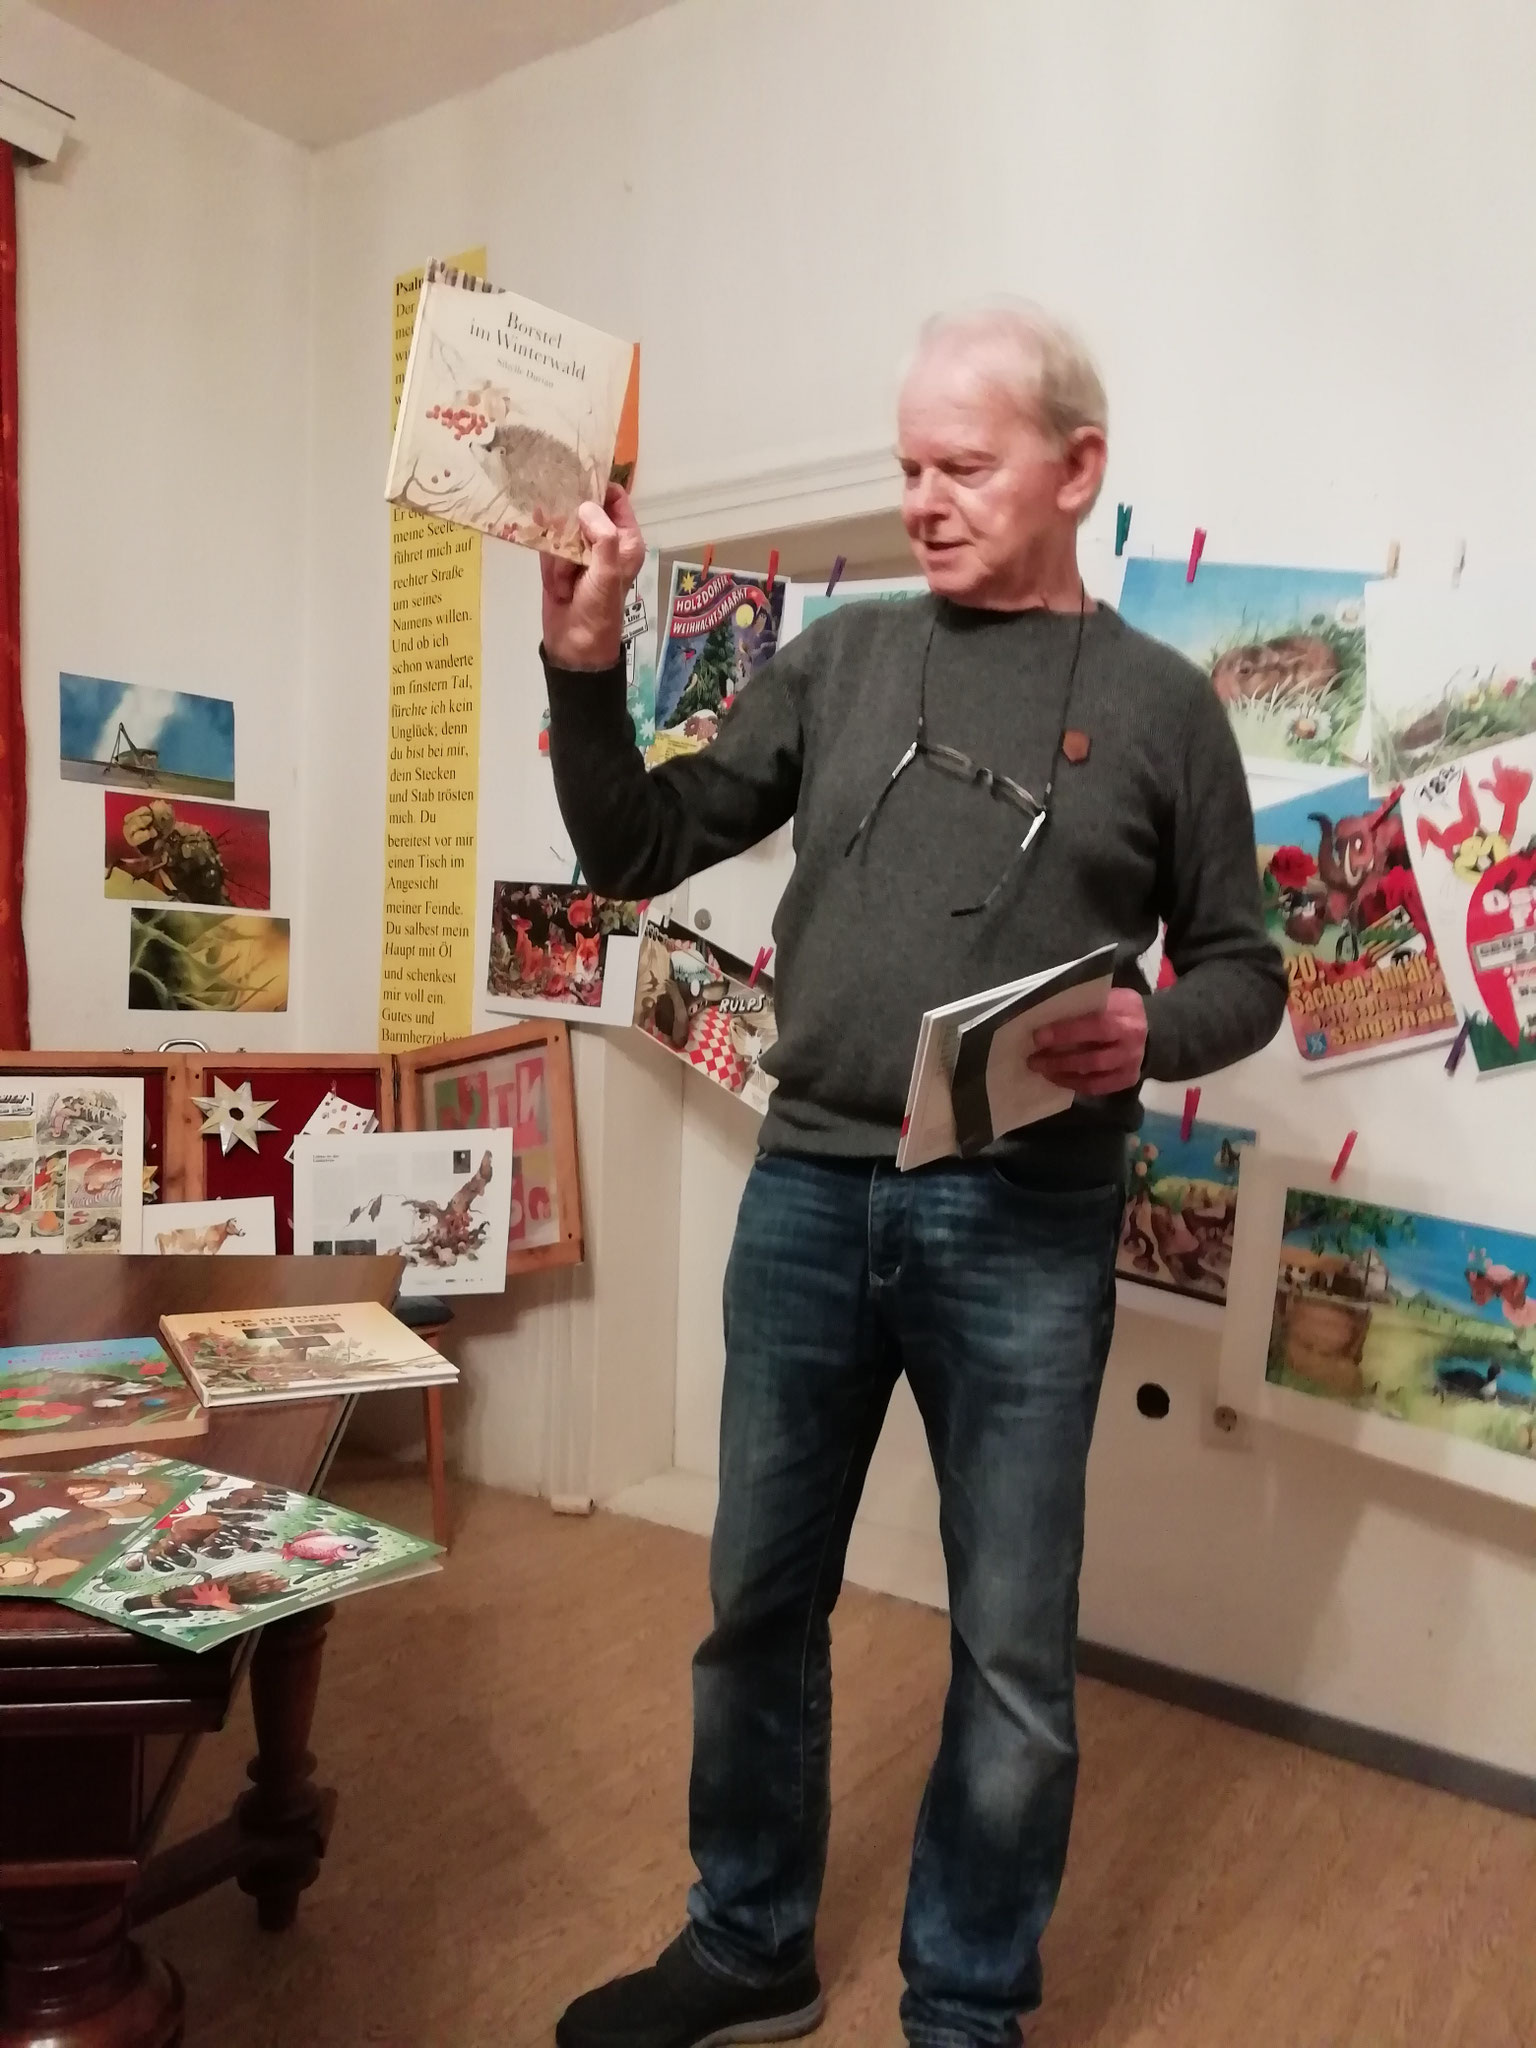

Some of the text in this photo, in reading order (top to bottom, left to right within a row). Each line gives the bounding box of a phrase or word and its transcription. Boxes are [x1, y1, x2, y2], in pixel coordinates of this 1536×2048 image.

[396, 303, 416, 318] Der
[395, 324, 414, 340] mei
[507, 311, 563, 349] Borstel
[469, 318, 586, 382] im Winterwald
[393, 508, 404, 522] Er
[393, 527, 424, 544] meine
[393, 536, 474, 565] führet mich auf
[393, 565, 464, 590] rechter Straße
[393, 593, 443, 611] um seines
[673, 587, 748, 635] WEIHNACHTSMARKT
[393, 610, 472, 632] Namens willen.
[392, 634, 449, 653] Und ob ich
[392, 654, 474, 674] schon wanderte
[392, 682, 406, 696] im
[409, 679, 448, 694] finstern
[391, 698, 473, 718] fürchte ich kein
[441, 721, 468, 736] denn
[390, 746, 403, 761] du
[406, 745, 425, 760] bist
[427, 743, 444, 757] bei
[390, 767, 456, 782] dein Stecken
[389, 788, 474, 803] und Stab trösten
[420, 809, 437, 823] Du
[388, 833, 474, 848] bereitest vor mir
[388, 854, 465, 869] einen Tisch im
[387, 876, 439, 893] Angesicht
[386, 902, 422, 915] meiner
[385, 921, 469, 937] Du salbest mein
[384, 940, 453, 960] Haupt mit Öl
[384, 967, 457, 985] und schenkest
[382, 990, 401, 1002] mir
[404, 989, 424, 1003] voll
[719, 993, 766, 1013] RÜLPS
[381, 1007, 435, 1025] Gutes und
[1330, 1001, 1456, 1046] Sangerhaus
[381, 1028, 465, 1045] Barmherzigk
